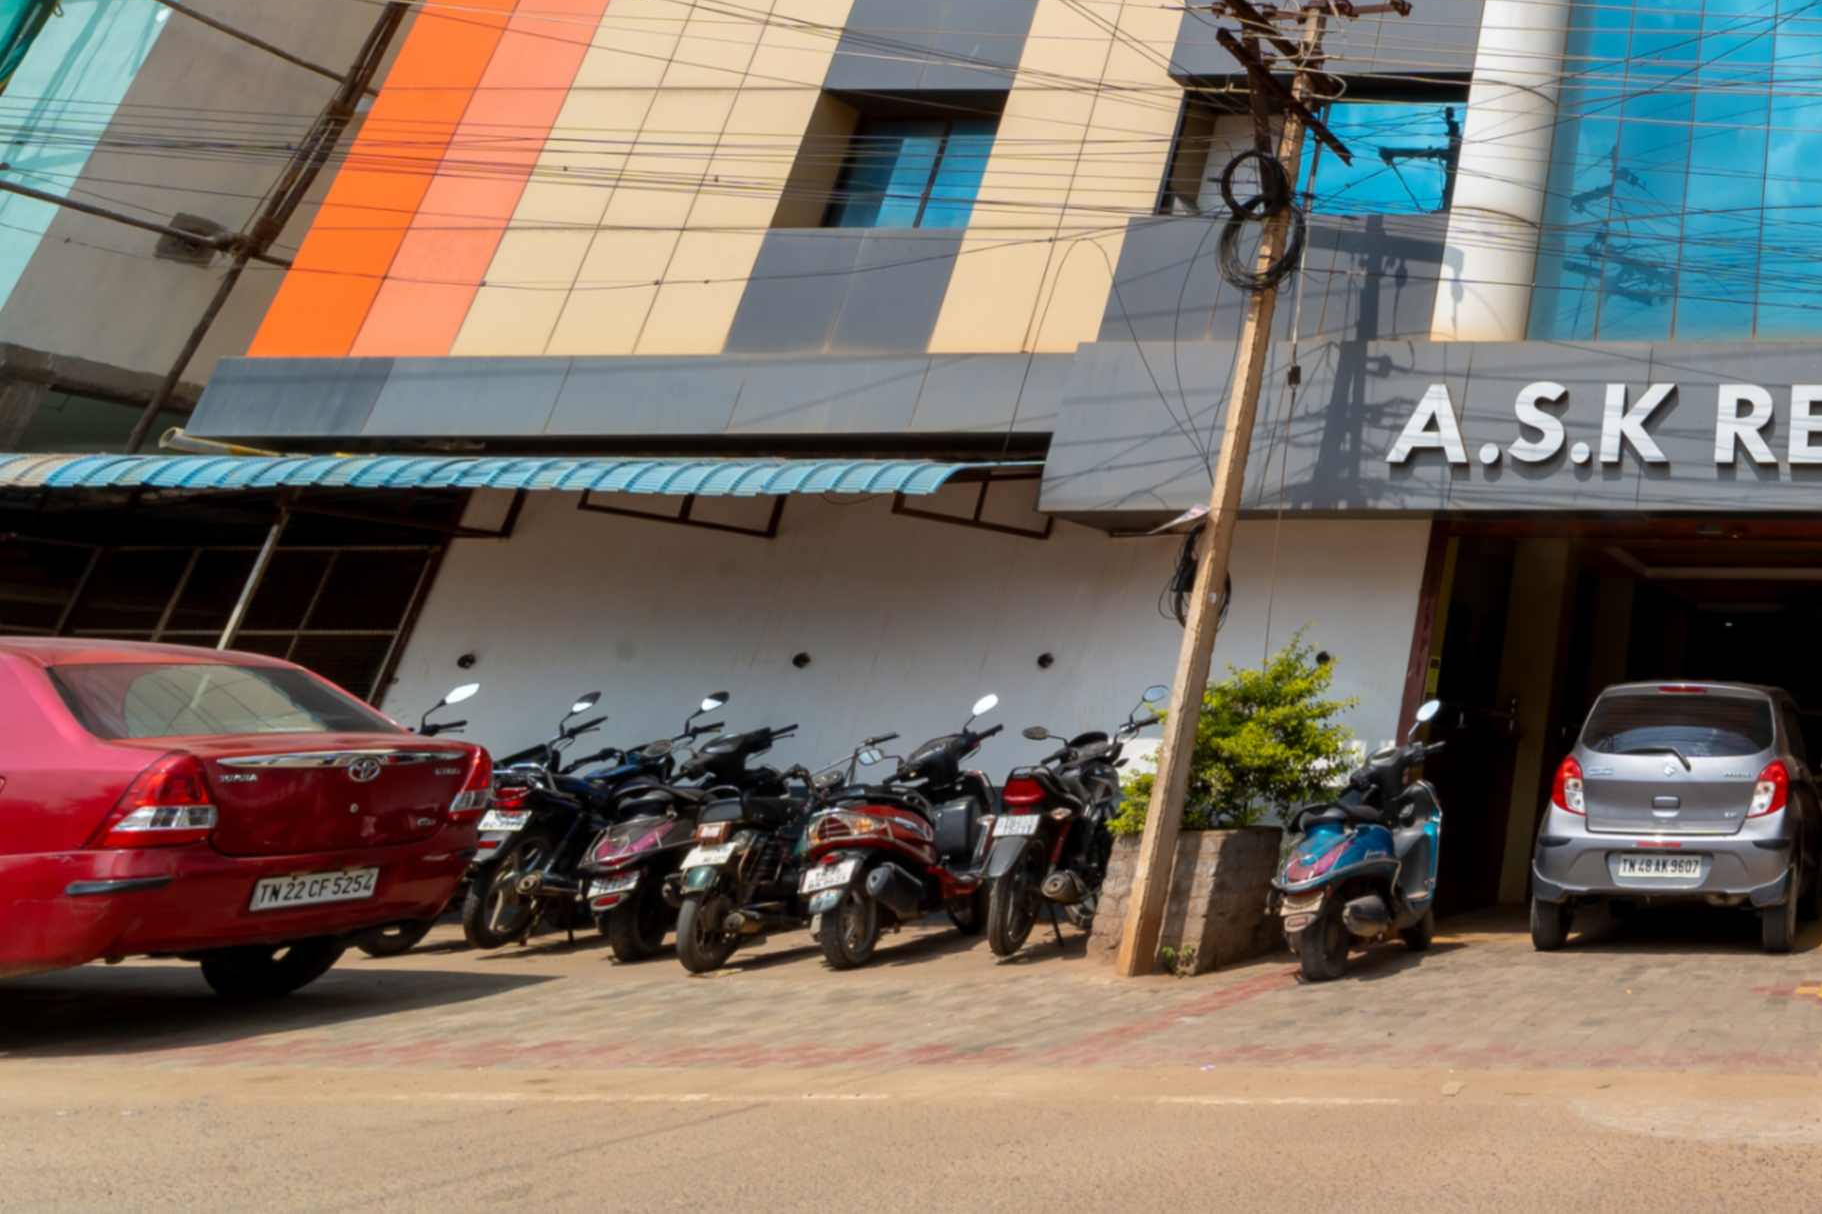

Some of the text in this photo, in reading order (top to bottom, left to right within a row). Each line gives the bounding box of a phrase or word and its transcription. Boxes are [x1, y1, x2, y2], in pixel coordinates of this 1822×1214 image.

[1385, 381, 1679, 464] A.S.K
[1622, 857, 1636, 874] TN
[1654, 858, 1670, 874] AK
[1671, 859, 1699, 874] 9607
[261, 883, 282, 904] TN
[282, 880, 306, 902] 22
[307, 877, 331, 900] CF
